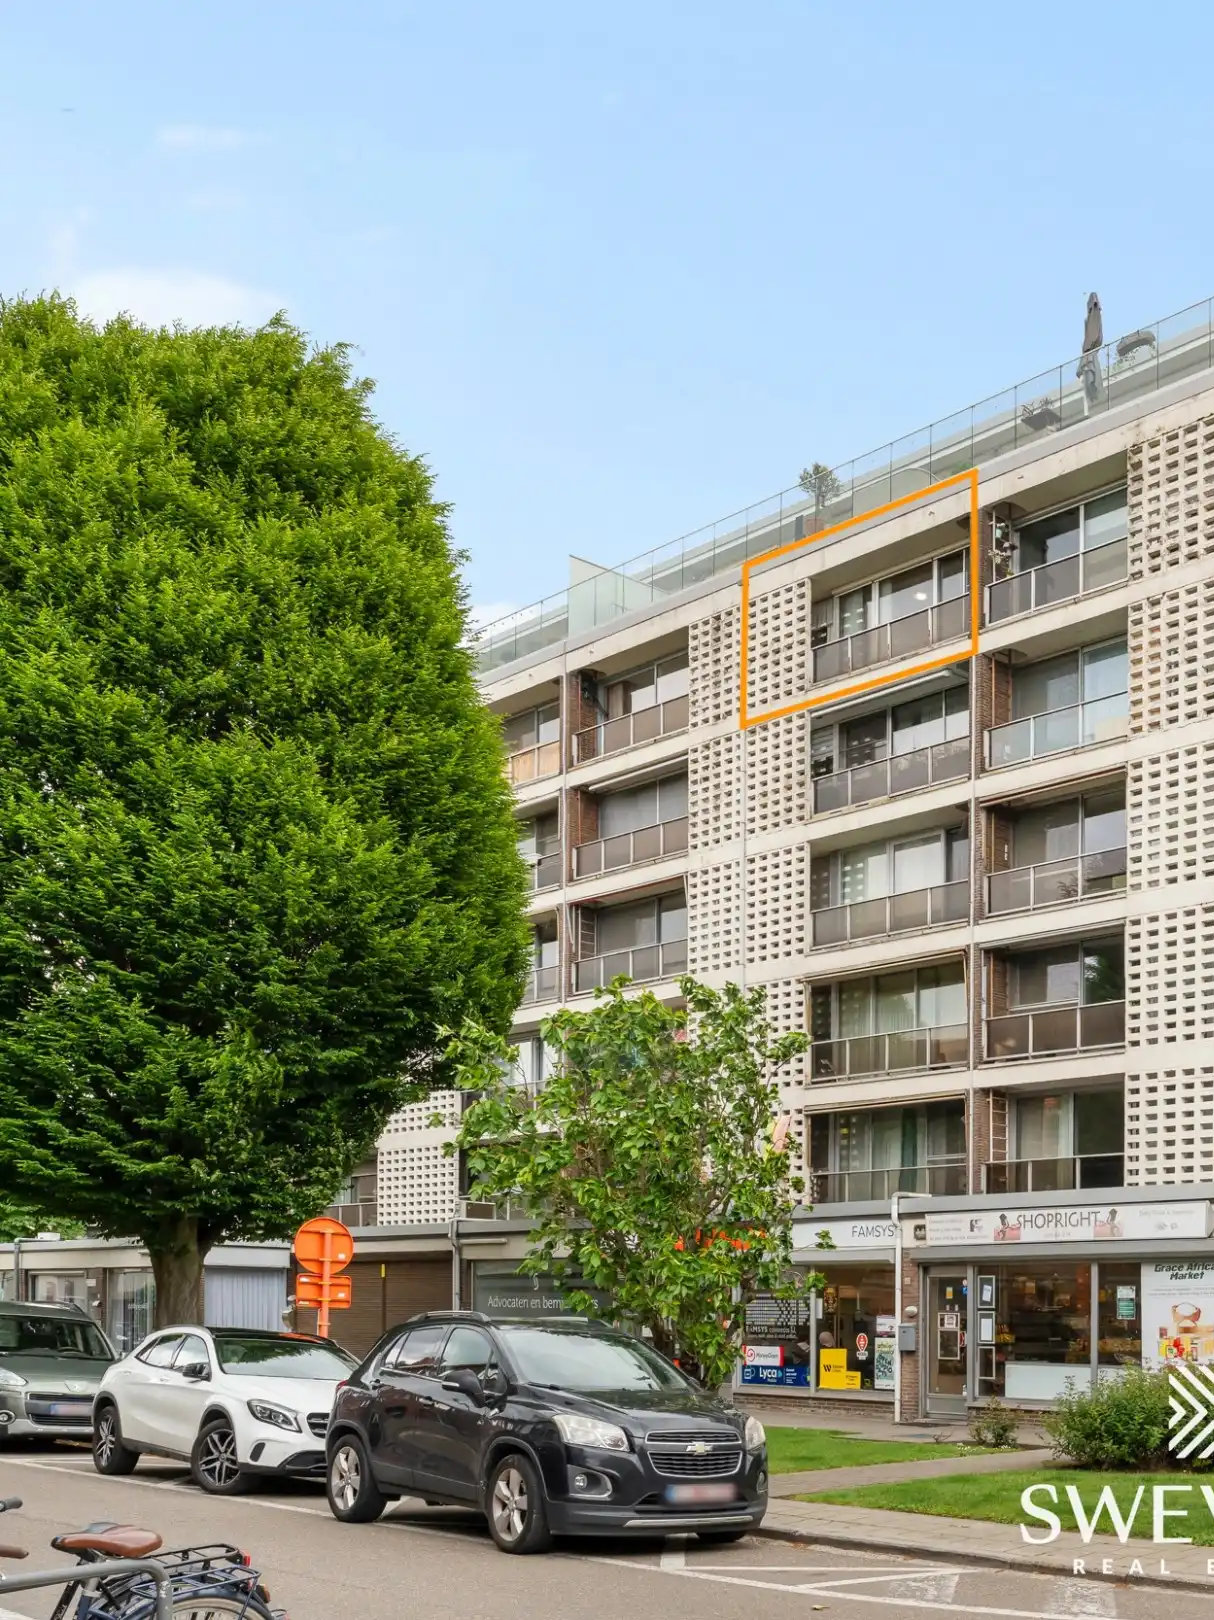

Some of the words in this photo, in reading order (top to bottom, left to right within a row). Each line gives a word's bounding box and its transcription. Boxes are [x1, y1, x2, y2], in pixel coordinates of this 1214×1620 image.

[1017, 1211, 1100, 1229] SHOPRIGHT
[852, 1224, 894, 1238] FAMSYS
[1154, 1264, 1184, 1272] Grace
[1170, 1271, 1204, 1280] Market
[487, 1296, 528, 1308] Advocaten
[530, 1300, 540, 1308] en
[759, 1366, 777, 1379] Lyca
